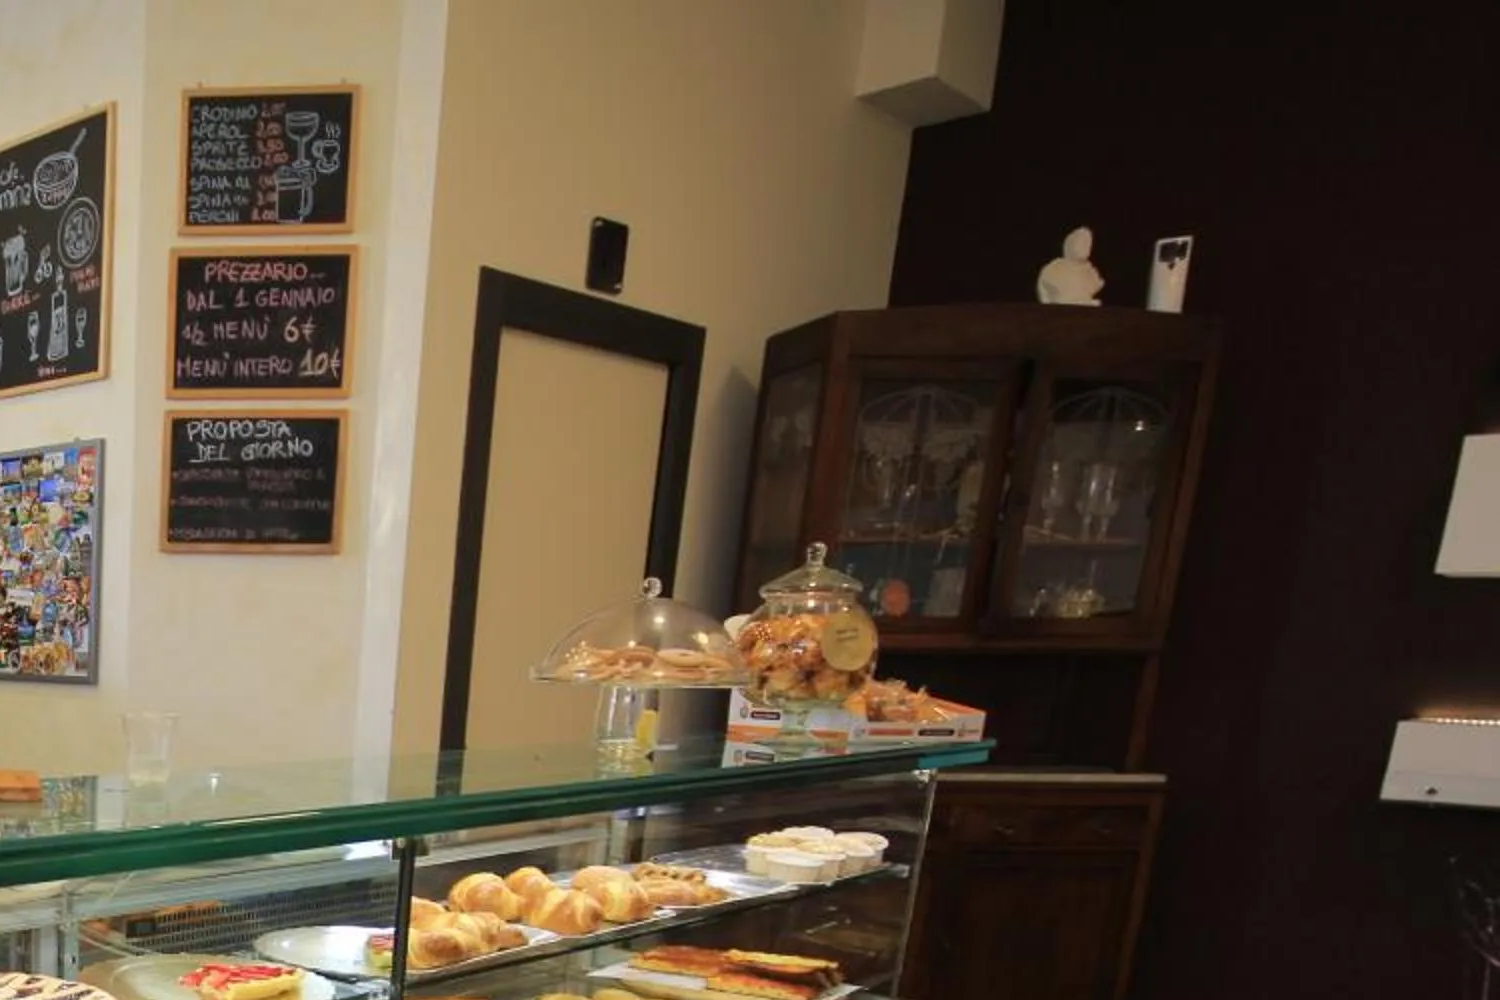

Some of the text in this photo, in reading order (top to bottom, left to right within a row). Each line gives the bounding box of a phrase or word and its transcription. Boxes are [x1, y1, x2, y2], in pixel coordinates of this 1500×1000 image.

[186, 287, 336, 312] DAL 1 GENNAIO
[233, 355, 293, 377] INTERO
[186, 419, 291, 442] PROPOSTA
[189, 436, 314, 463] DEL GIORNO
